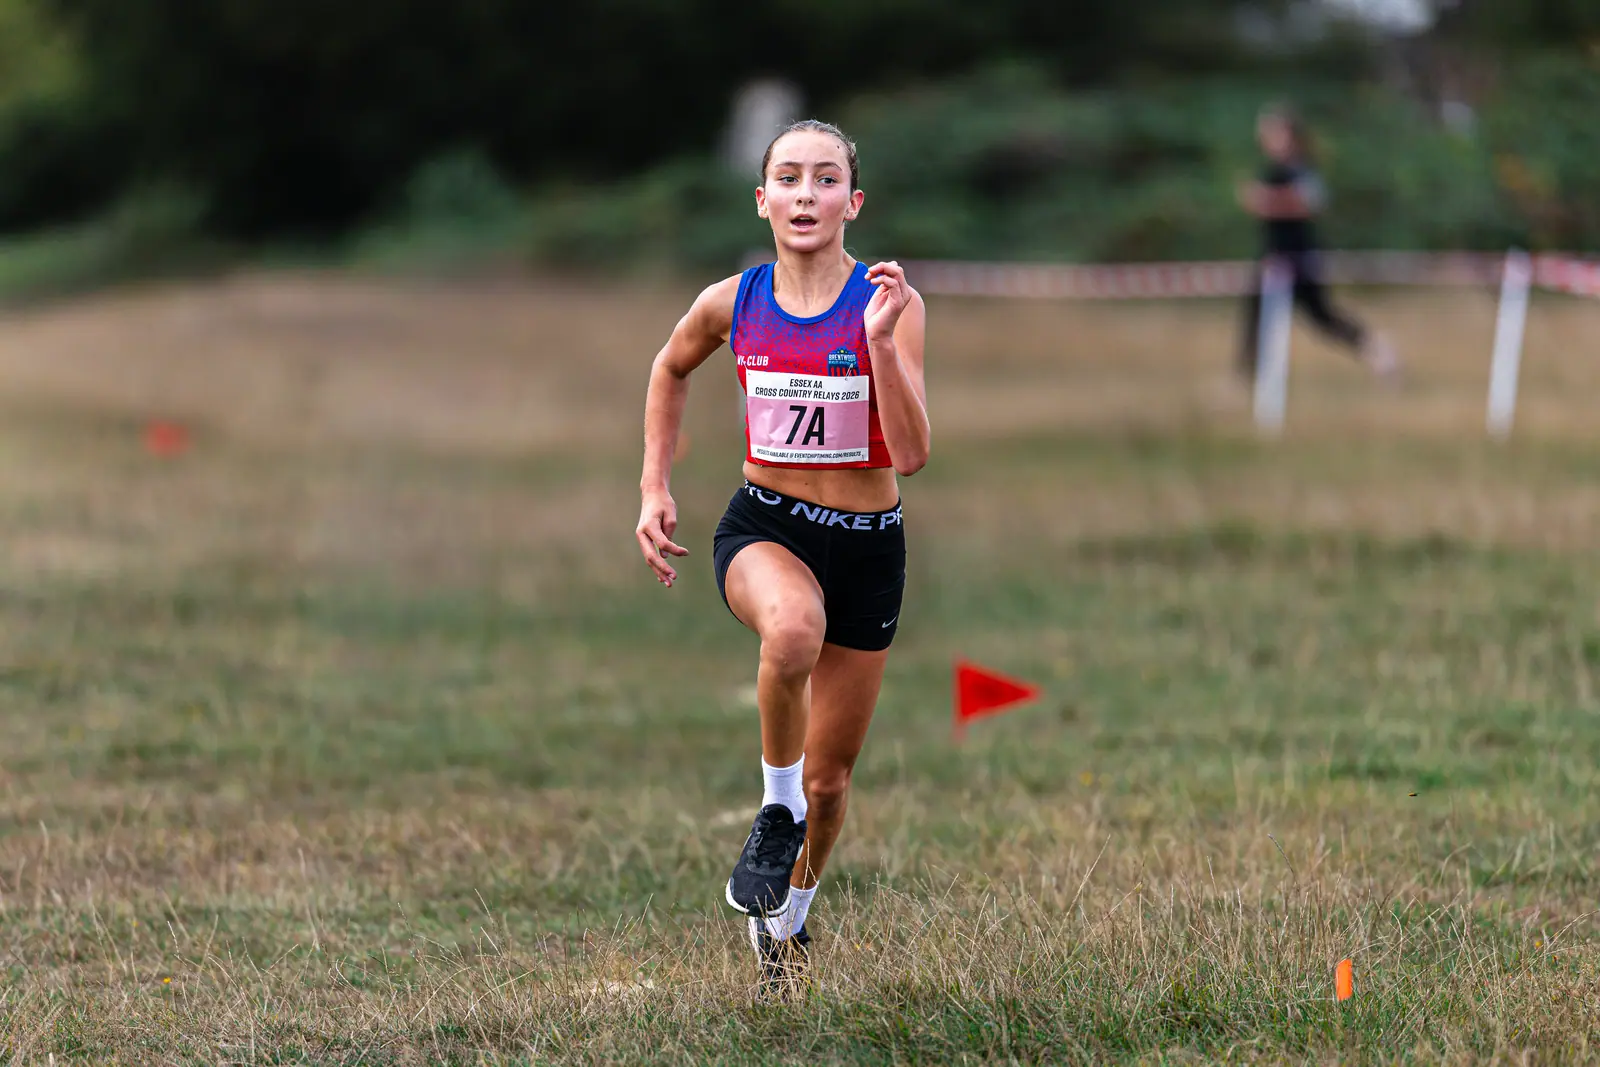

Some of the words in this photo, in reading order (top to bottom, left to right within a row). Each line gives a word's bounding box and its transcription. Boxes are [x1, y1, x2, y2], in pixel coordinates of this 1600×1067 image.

[747, 355, 769, 366] CLUB
[790, 379, 812, 388] ESSEX
[813, 380, 823, 389] AA
[755, 386, 777, 397] CROSS
[779, 388, 812, 398] COUNTRY
[813, 390, 840, 400] RELAYS
[841, 390, 860, 400] 2026
[785, 405, 824, 446] 7A
[790, 502, 876, 530] NIKE
